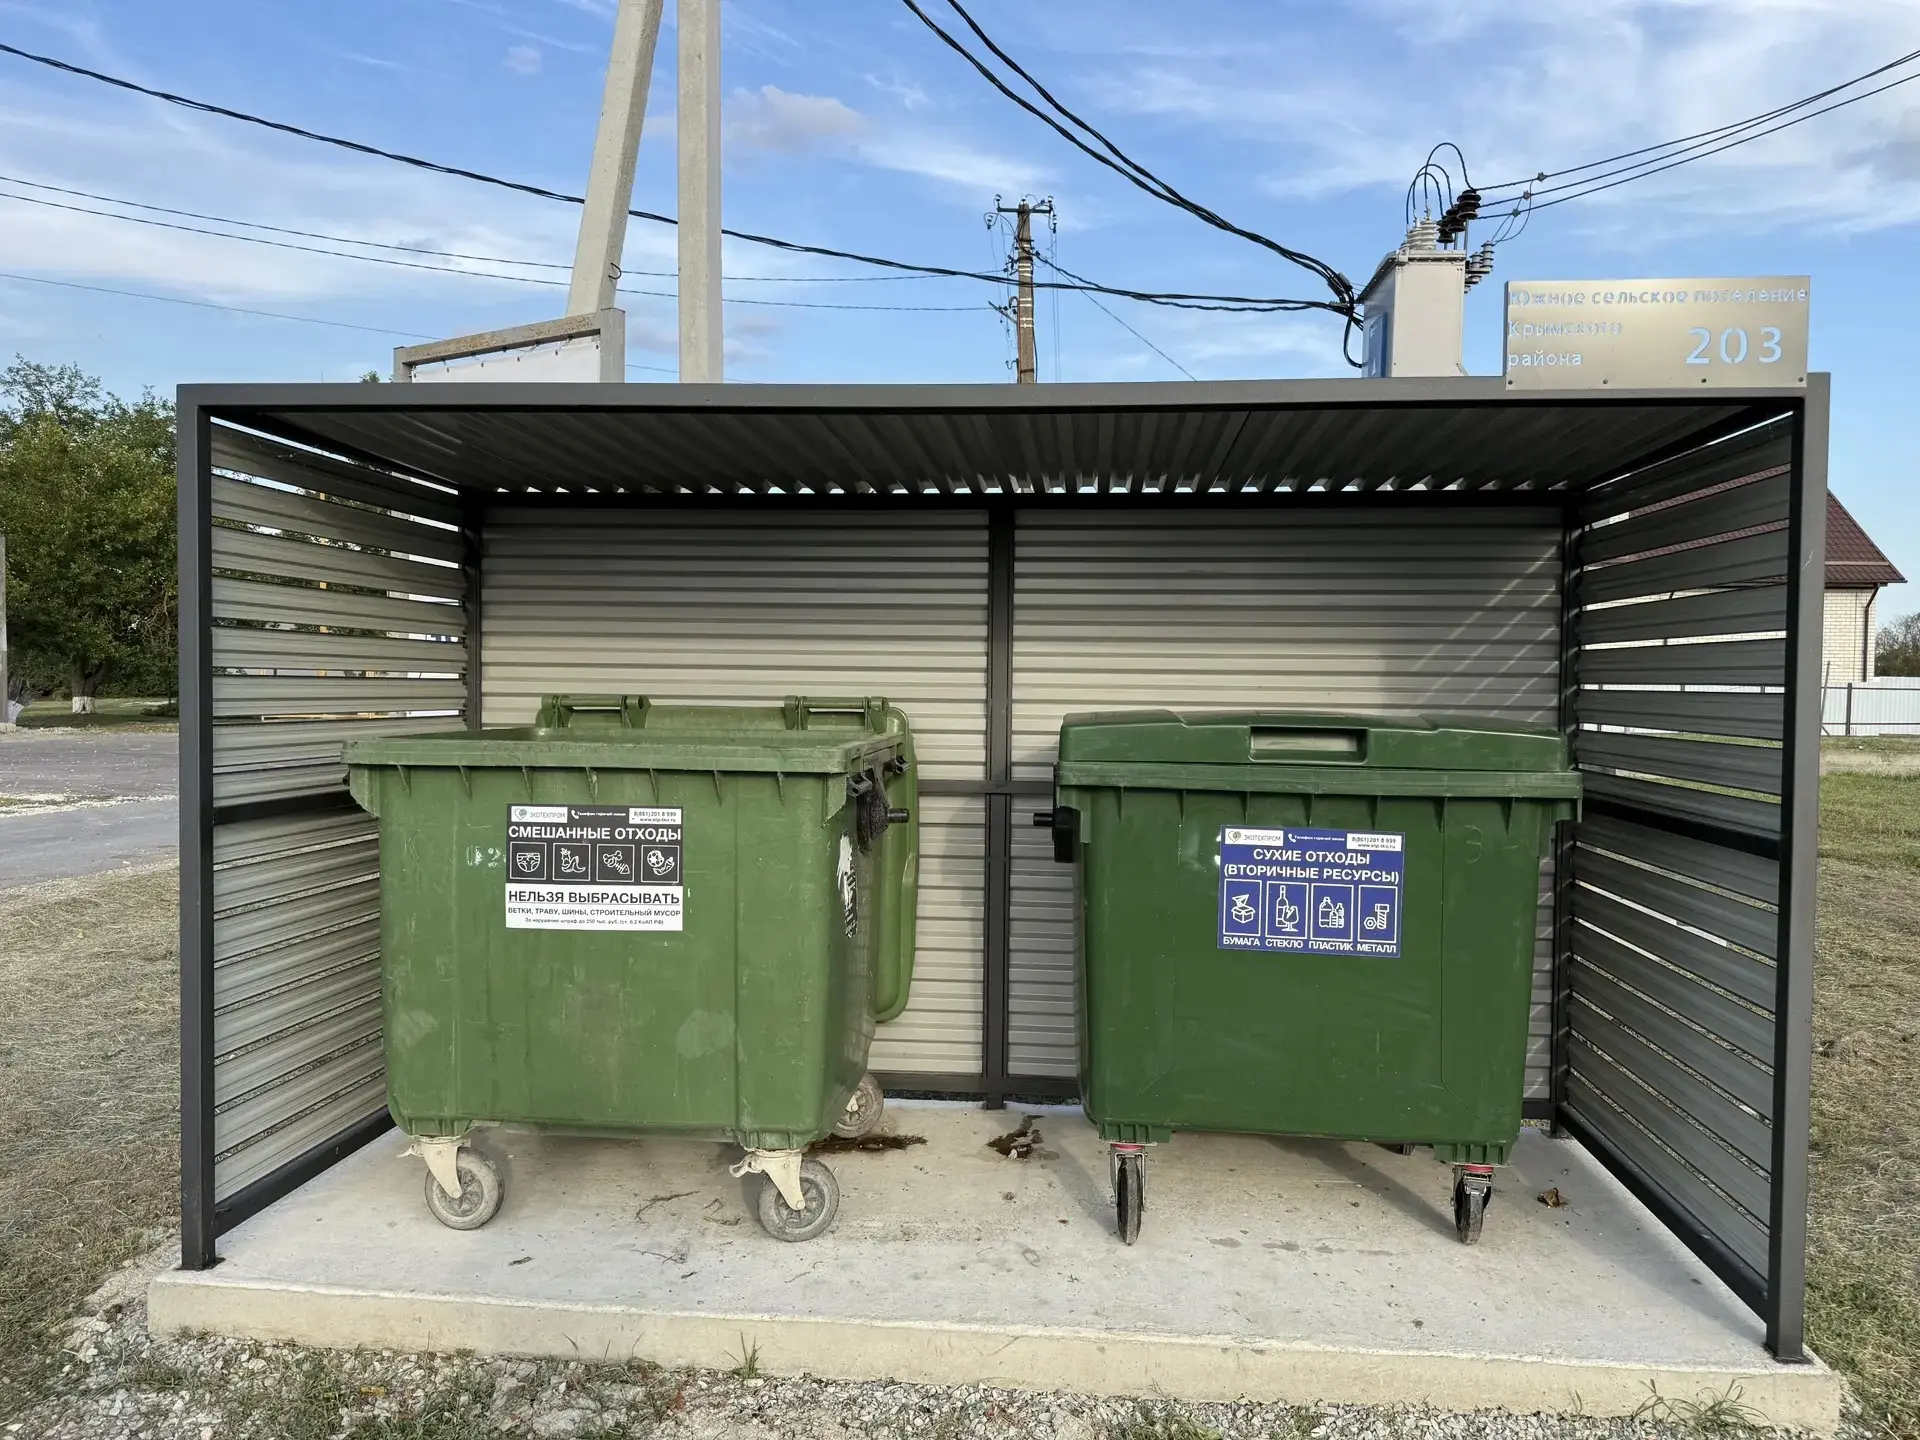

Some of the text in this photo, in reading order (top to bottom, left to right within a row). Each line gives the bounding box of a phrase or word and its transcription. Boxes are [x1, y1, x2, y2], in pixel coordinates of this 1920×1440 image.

[1508, 288, 1807, 306] Южное сельское поселение
[1508, 320, 1622, 340] Крымского
[1685, 326, 1783, 365] 203
[1508, 350, 1583, 370] района
[508, 825, 681, 842] СМЕШАННЫЕ ОТХОДЫ
[1253, 849, 1370, 866] СУХИЕ ОТХОДЫ
[1224, 863, 1399, 884] (ВТОРИЧНЫЕ РЕСУРСЫ)
[509, 891, 680, 904] НЕЛЬЗЯ ВЫБРАСЫВАТЬ
[508, 907, 533, 915] ВЕТКИ,
[535, 908, 560, 916] ТРАВУ,
[590, 908, 652, 916] СТРОИТЕЛЬНЫЙ
[1223, 937, 1260, 946] БУМАГА
[1265, 938, 1304, 949] СТЕКЛО
[1309, 941, 1353, 951] ПЛАСТИК
[1357, 943, 1396, 953] МЕТАЛЛ
